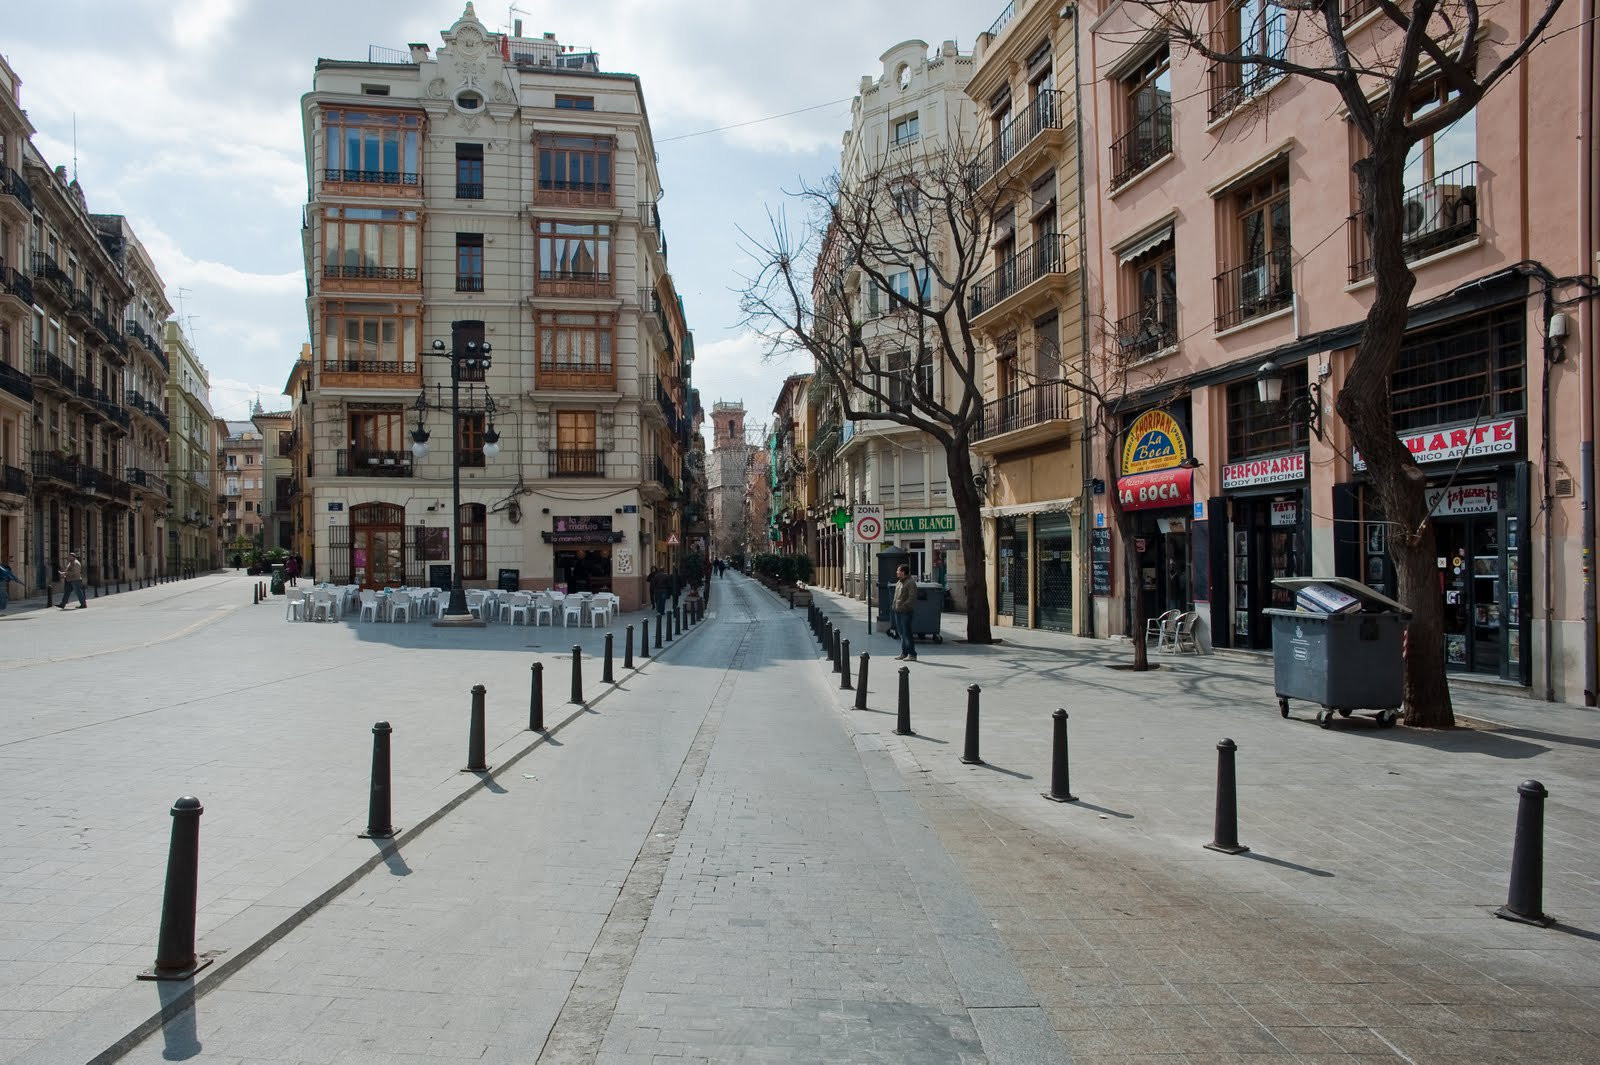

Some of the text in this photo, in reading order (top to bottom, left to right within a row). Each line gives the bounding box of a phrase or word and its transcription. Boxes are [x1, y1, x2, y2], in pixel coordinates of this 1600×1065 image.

[1148, 431, 1162, 446] La
[1406, 421, 1514, 453] UARTE
[1136, 445, 1171, 459] Boca
[1416, 452, 1442, 461] NICO
[1223, 455, 1304, 480] PERFOR'ARTE
[1224, 471, 1304, 488] BODY PIERCING
[1119, 482, 1179, 504] LA BOCA
[1272, 502, 1296, 512] TATT
[1452, 505, 1494, 514] TATUAJES
[862, 525, 876, 533] 30
[884, 517, 953, 531] RMACIA BLANCH
